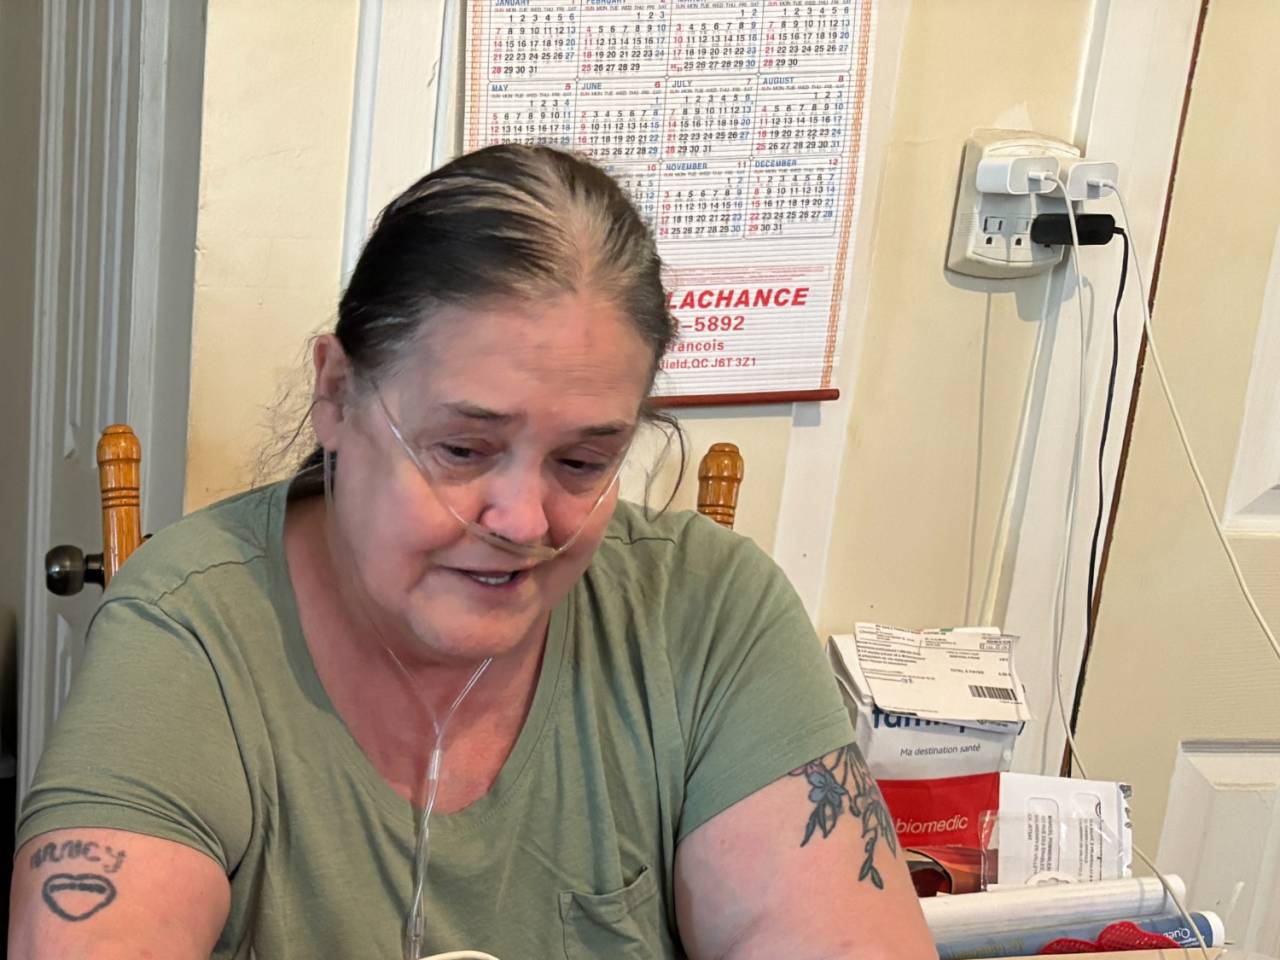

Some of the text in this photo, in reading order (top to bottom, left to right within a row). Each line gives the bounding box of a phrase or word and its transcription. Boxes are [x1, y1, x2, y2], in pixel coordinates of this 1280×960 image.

[732, 213, 742, 221] 23
[666, 287, 809, 310] LACHANCE
[736, 356, 756, 367] 3Z1
[900, 743, 981, 756] Ma destination santé
[895, 814, 968, 834] biomedic
